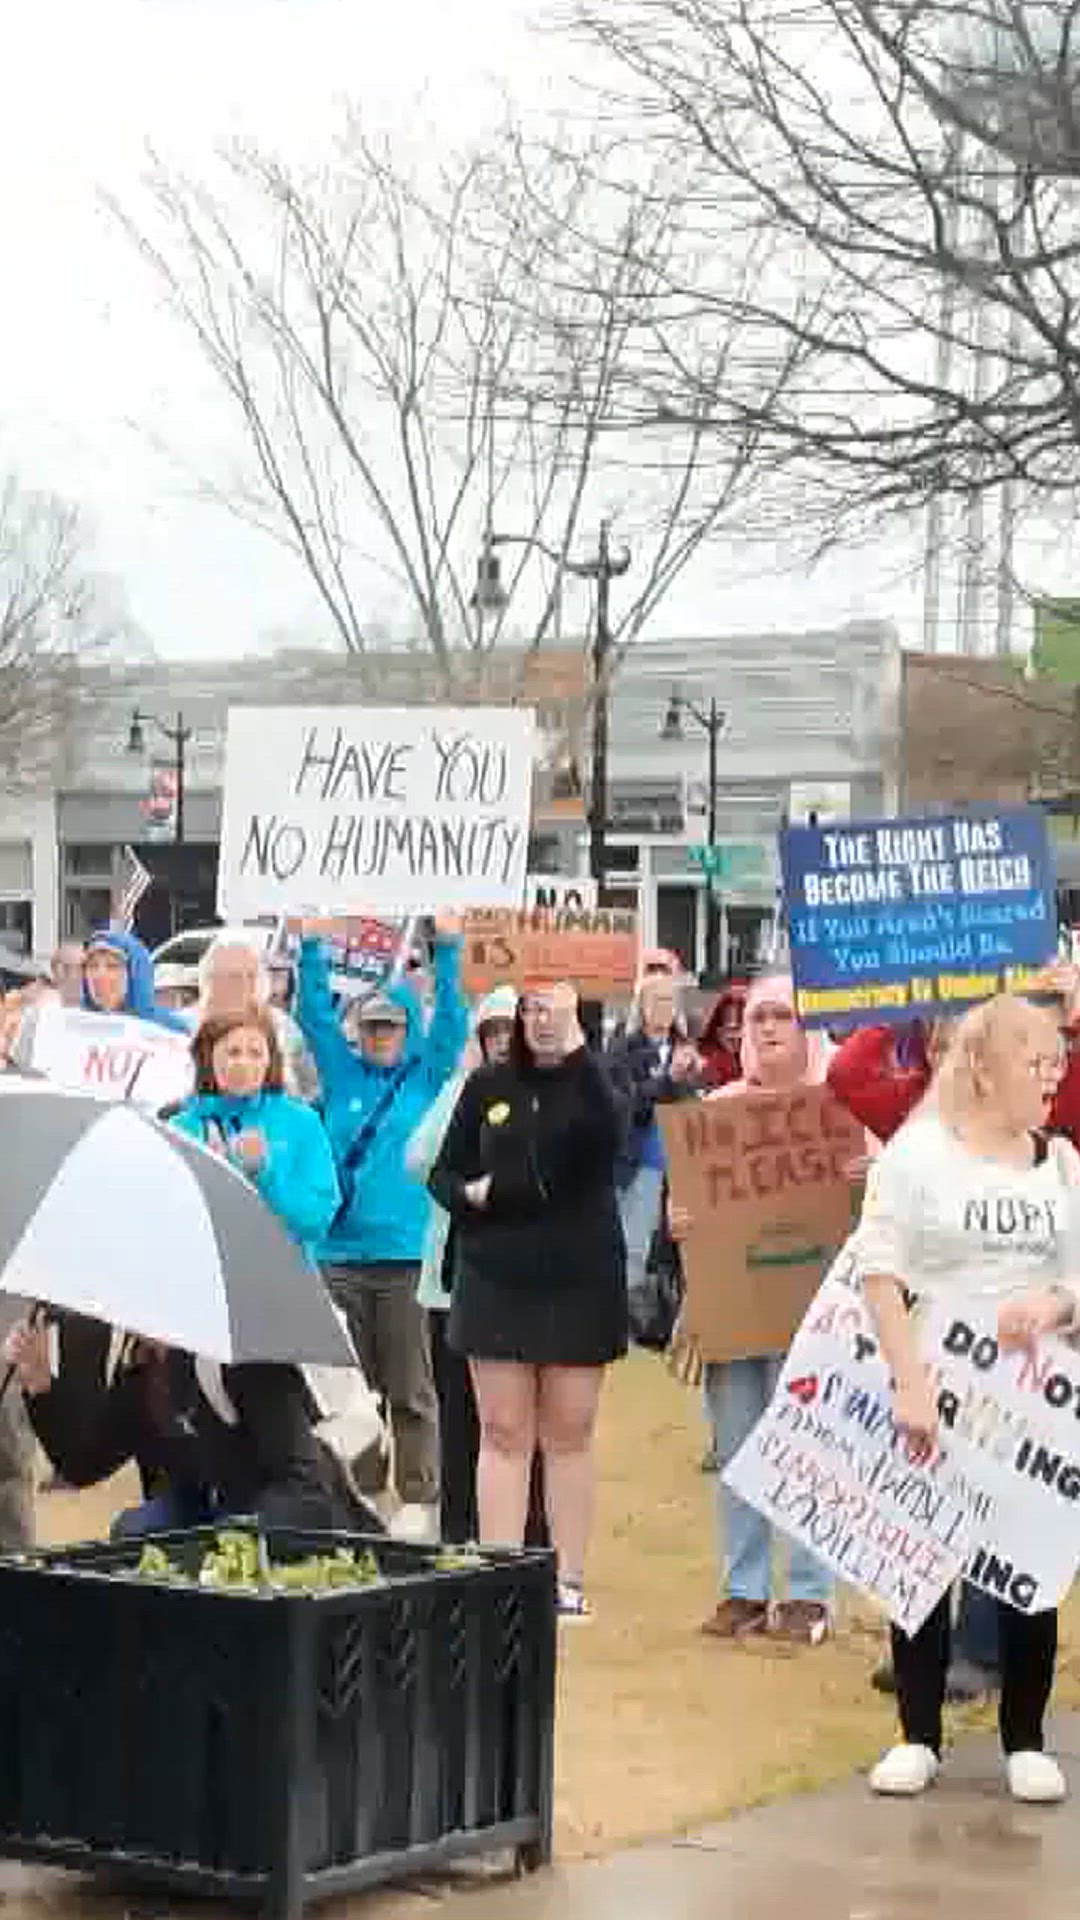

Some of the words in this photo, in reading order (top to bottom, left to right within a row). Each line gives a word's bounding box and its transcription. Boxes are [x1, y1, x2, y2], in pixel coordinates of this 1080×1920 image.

[294, 726, 412, 801] HAVE
[431, 725, 508, 804] YOU
[240, 815, 306, 880] NO
[319, 815, 521, 885] HUMANITY
[823, 833, 872, 868] THE
[876, 825, 944, 865] RIGHT
[953, 820, 1000, 854] HAS
[804, 870, 902, 906] BECOME
[908, 860, 953, 893] THE
[960, 854, 1030, 893] REICH
[944, 1320, 998, 1370] DO
